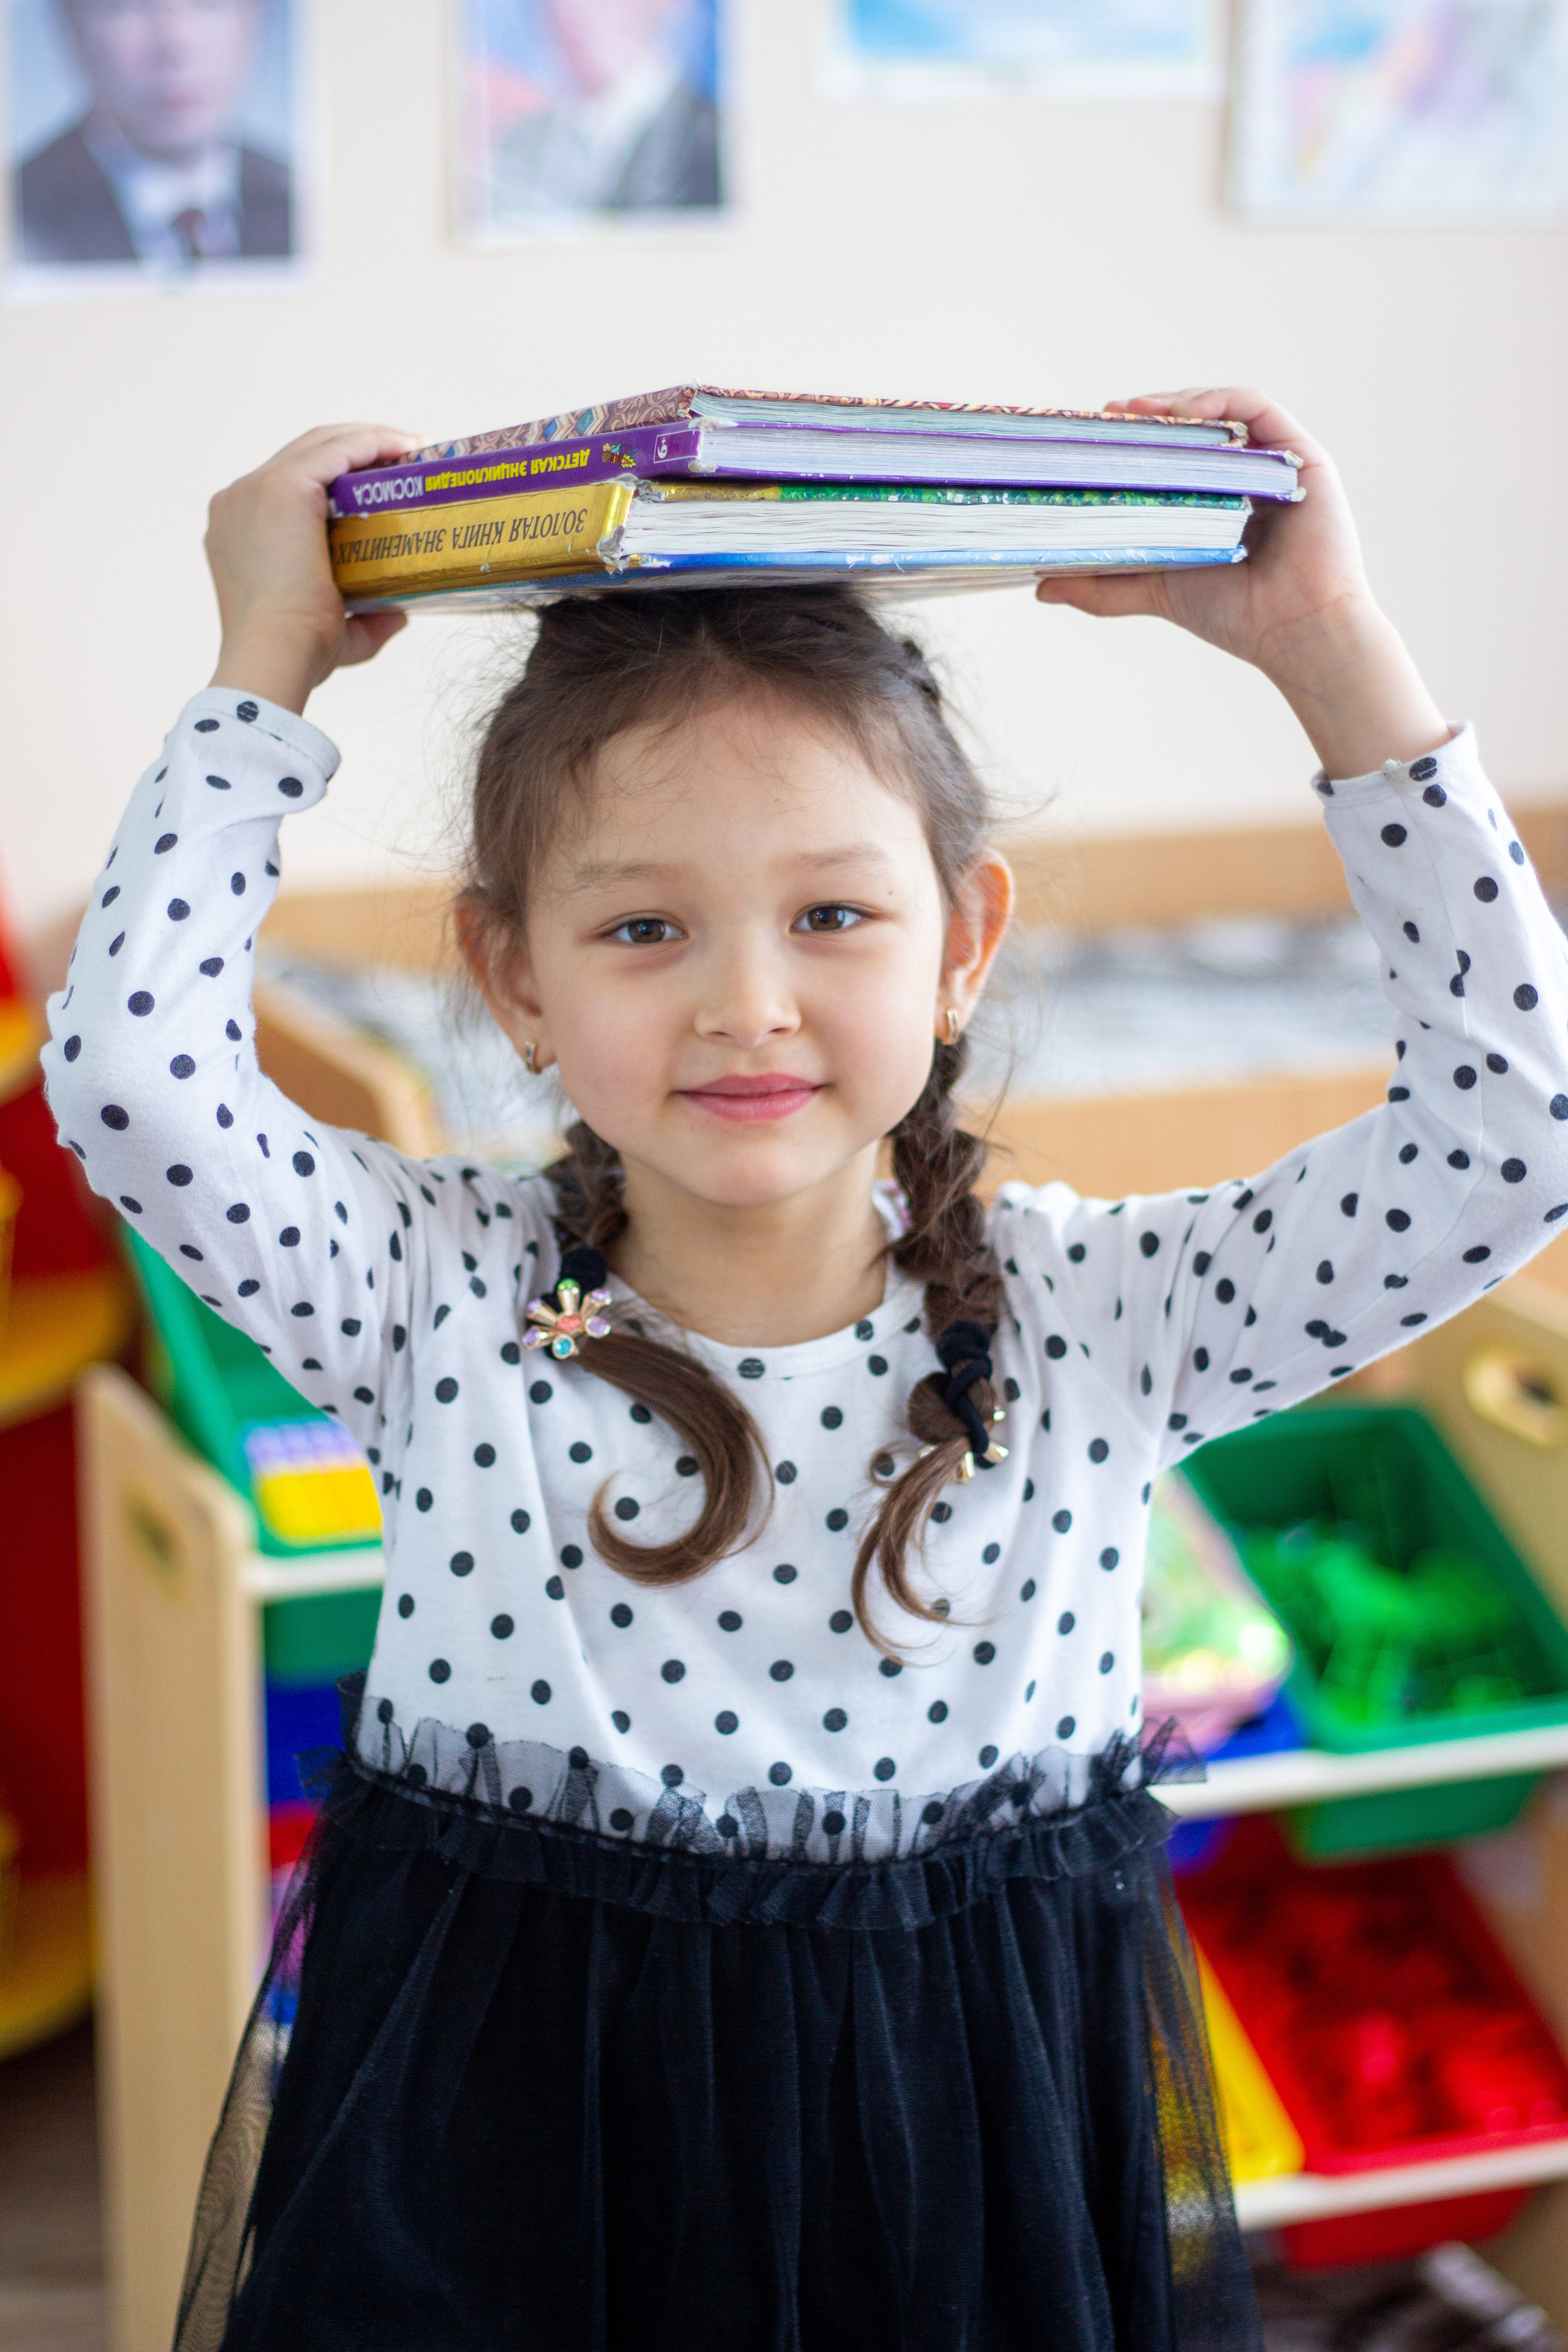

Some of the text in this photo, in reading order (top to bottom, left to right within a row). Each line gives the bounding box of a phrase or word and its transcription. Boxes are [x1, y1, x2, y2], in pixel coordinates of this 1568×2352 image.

[657, 437, 668, 459] 6+
[352, 449, 590, 506] ДЕТСКАЯ ЭНЦИКЛОПЕДИЯ КОСМОСА
[452, 521, 506, 550] КНИГА
[508, 508, 588, 542] ЗОЛОТАЯ
[336, 529, 447, 566] ЗНАМЕНИТЫХ
